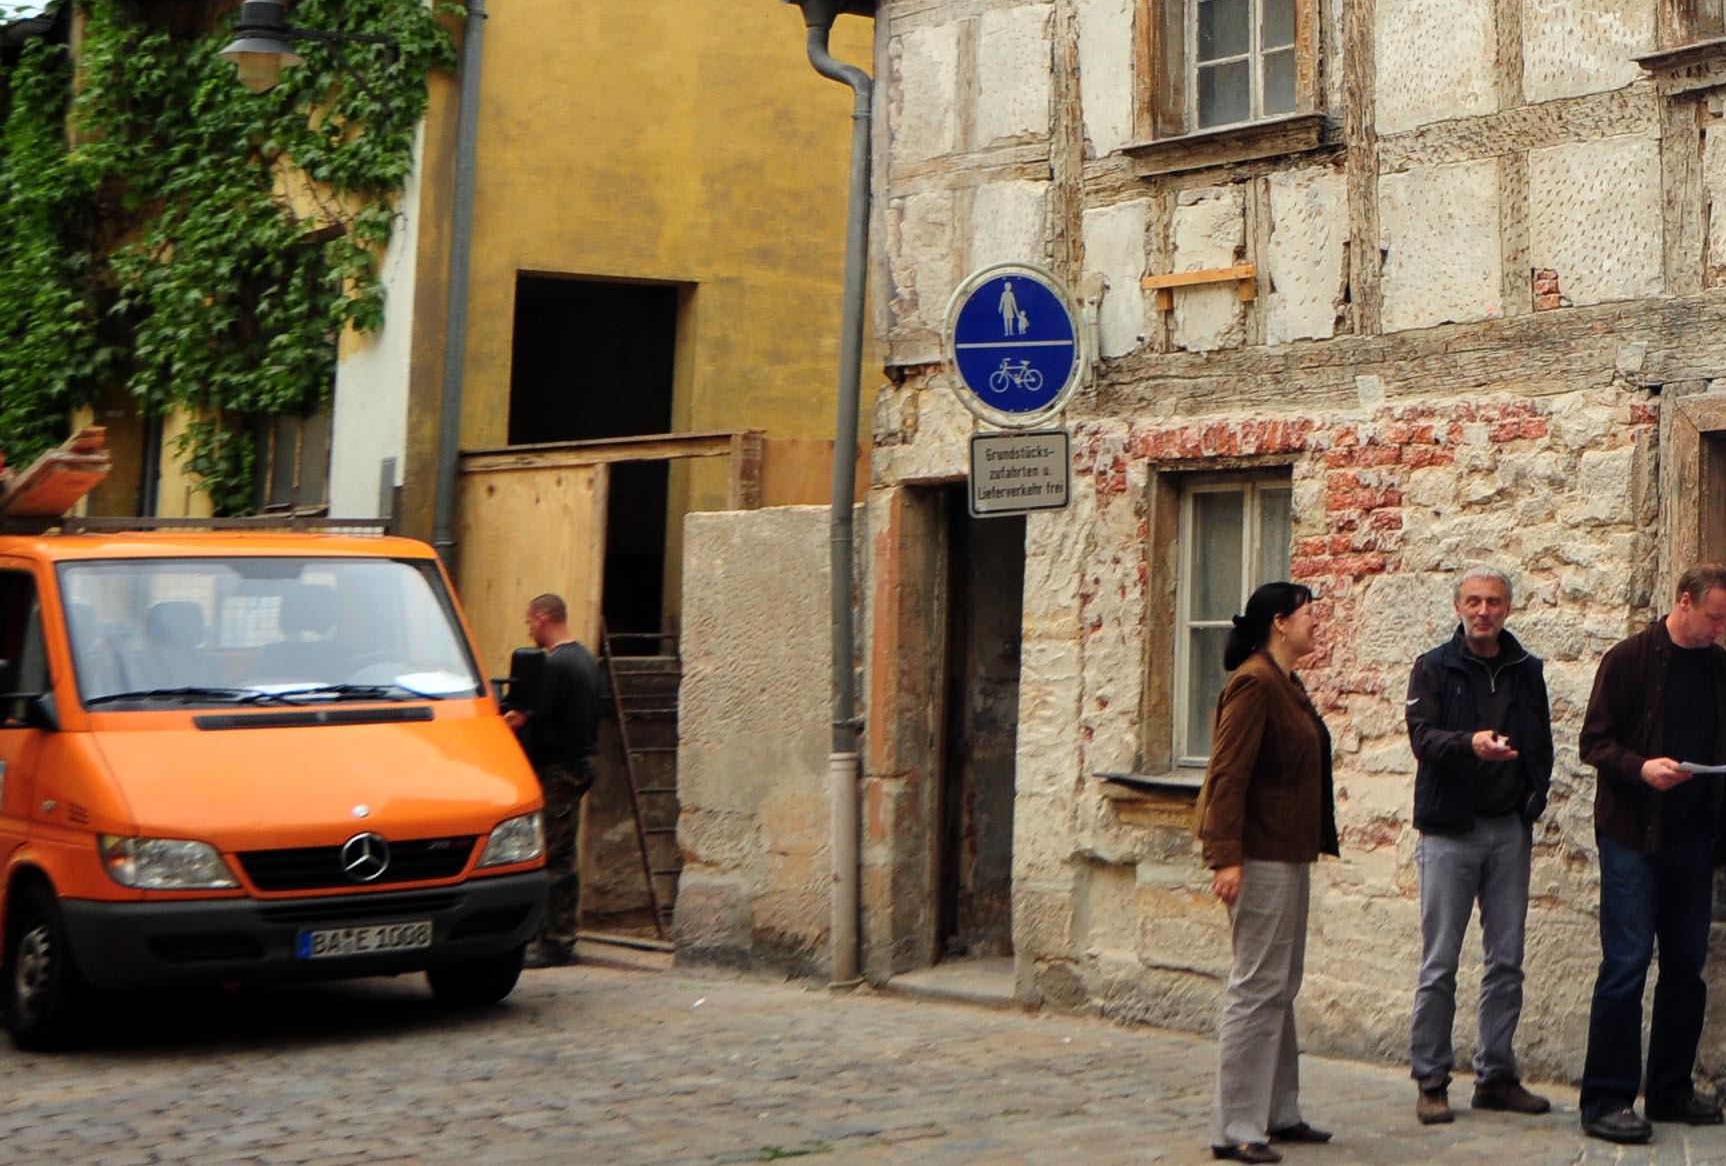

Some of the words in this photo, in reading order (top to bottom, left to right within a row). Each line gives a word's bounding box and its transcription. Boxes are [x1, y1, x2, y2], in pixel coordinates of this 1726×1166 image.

[985, 445, 1055, 462] Grundstücks-
[989, 465, 1039, 481] zufahrten
[978, 482, 1043, 501] Lieferverkehr
[1046, 479, 1064, 494] frei
